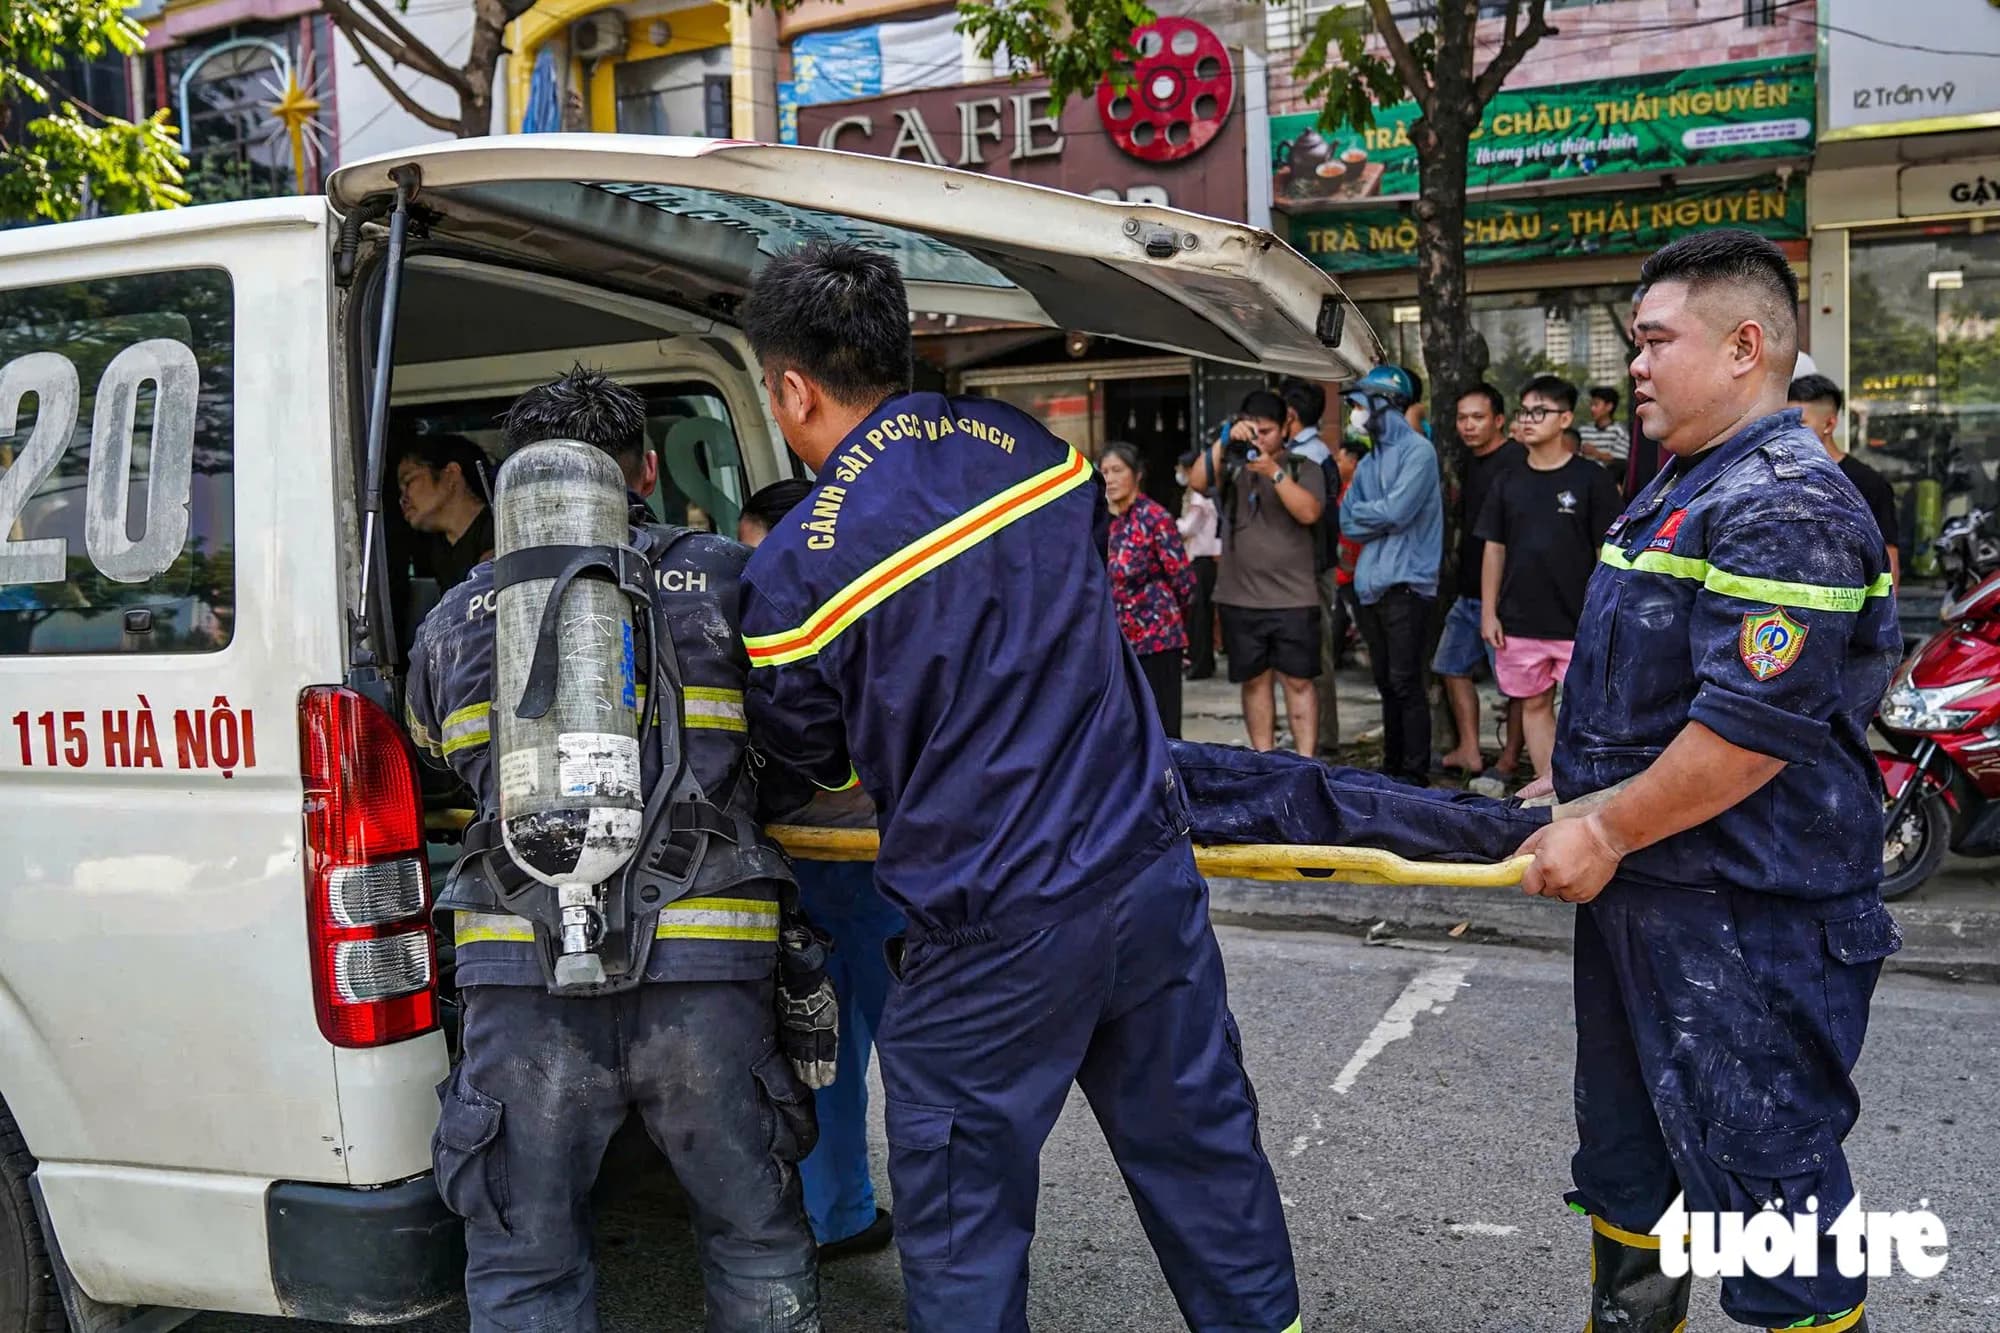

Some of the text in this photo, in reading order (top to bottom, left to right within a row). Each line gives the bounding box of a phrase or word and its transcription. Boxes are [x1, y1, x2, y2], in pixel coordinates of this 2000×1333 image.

[818, 90, 1065, 165] CAFE
[1364, 119, 1412, 151] TRÀ
[1492, 105, 1571, 137] CHÂU
[1595, 92, 1659, 126] THÁI
[1667, 80, 1789, 118] NGUYÊN
[1854, 89, 1871, 109] 12
[1307, 223, 1361, 254] TRÀ
[1369, 217, 1420, 256] MỘ
[1568, 200, 1641, 235] THÁI
[1650, 187, 1786, 229] NGUYÊN
[801, 484, 847, 551] CẢNH
[836, 443, 875, 484] SÁT
[865, 413, 922, 452] PCCC
[957, 418, 1016, 455] CNCH
[12, 693, 256, 779] 115 HÀ NỘI
